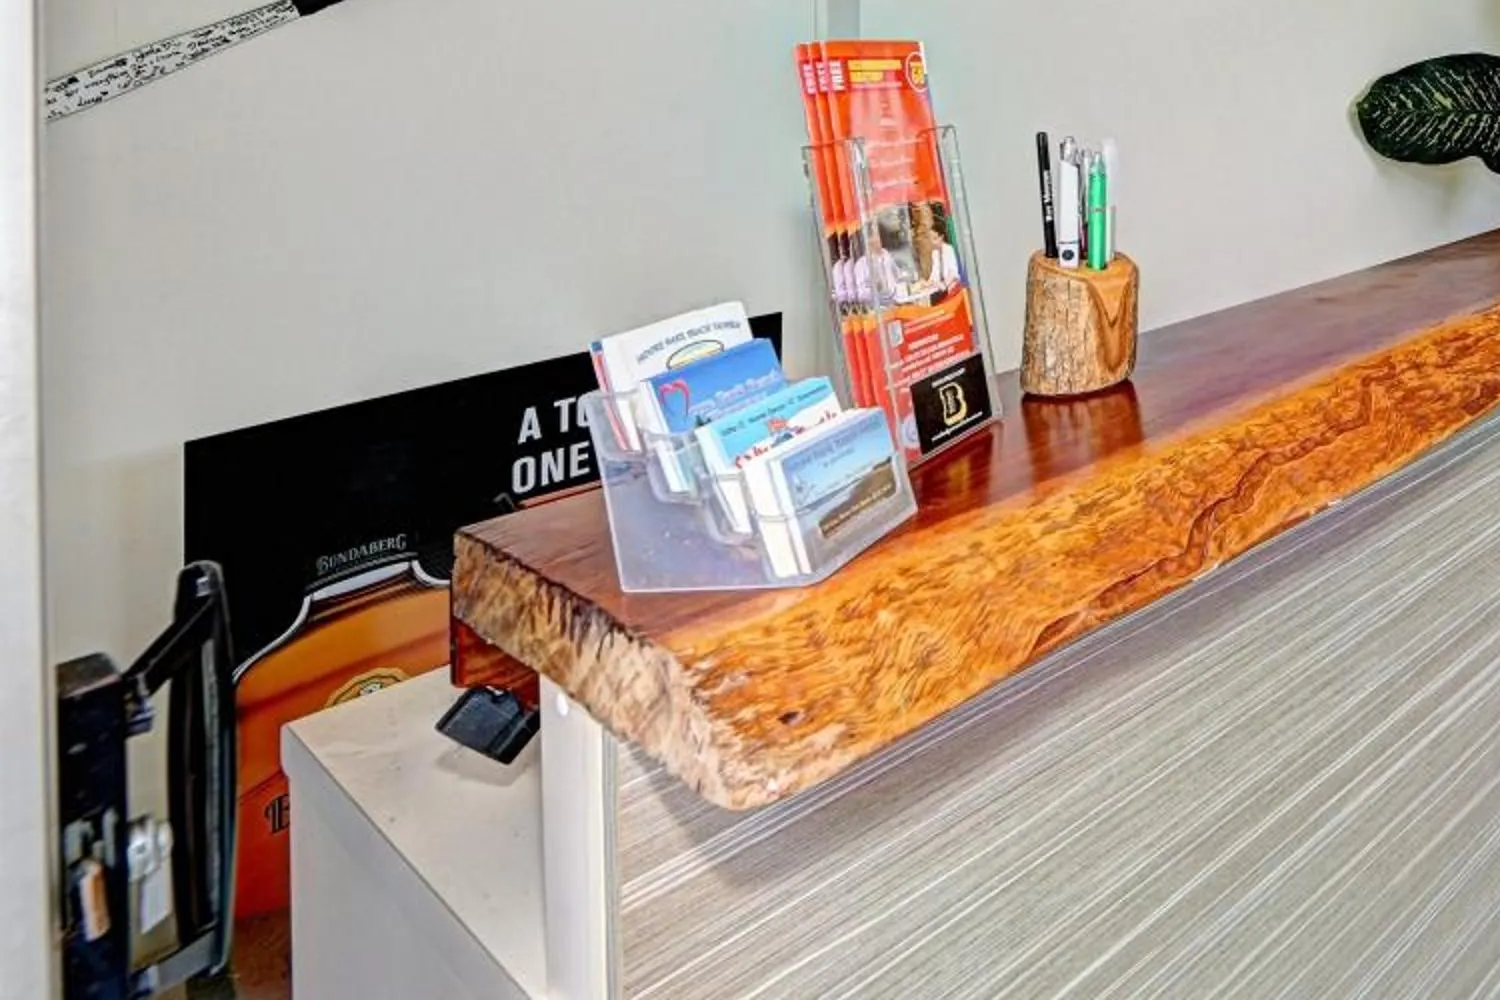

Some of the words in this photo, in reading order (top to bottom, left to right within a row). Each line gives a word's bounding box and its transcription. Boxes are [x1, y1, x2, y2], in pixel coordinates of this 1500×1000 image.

[517, 405, 543, 445] A
[511, 440, 591, 495] ONE
[315, 533, 408, 575] BUNDABERG
